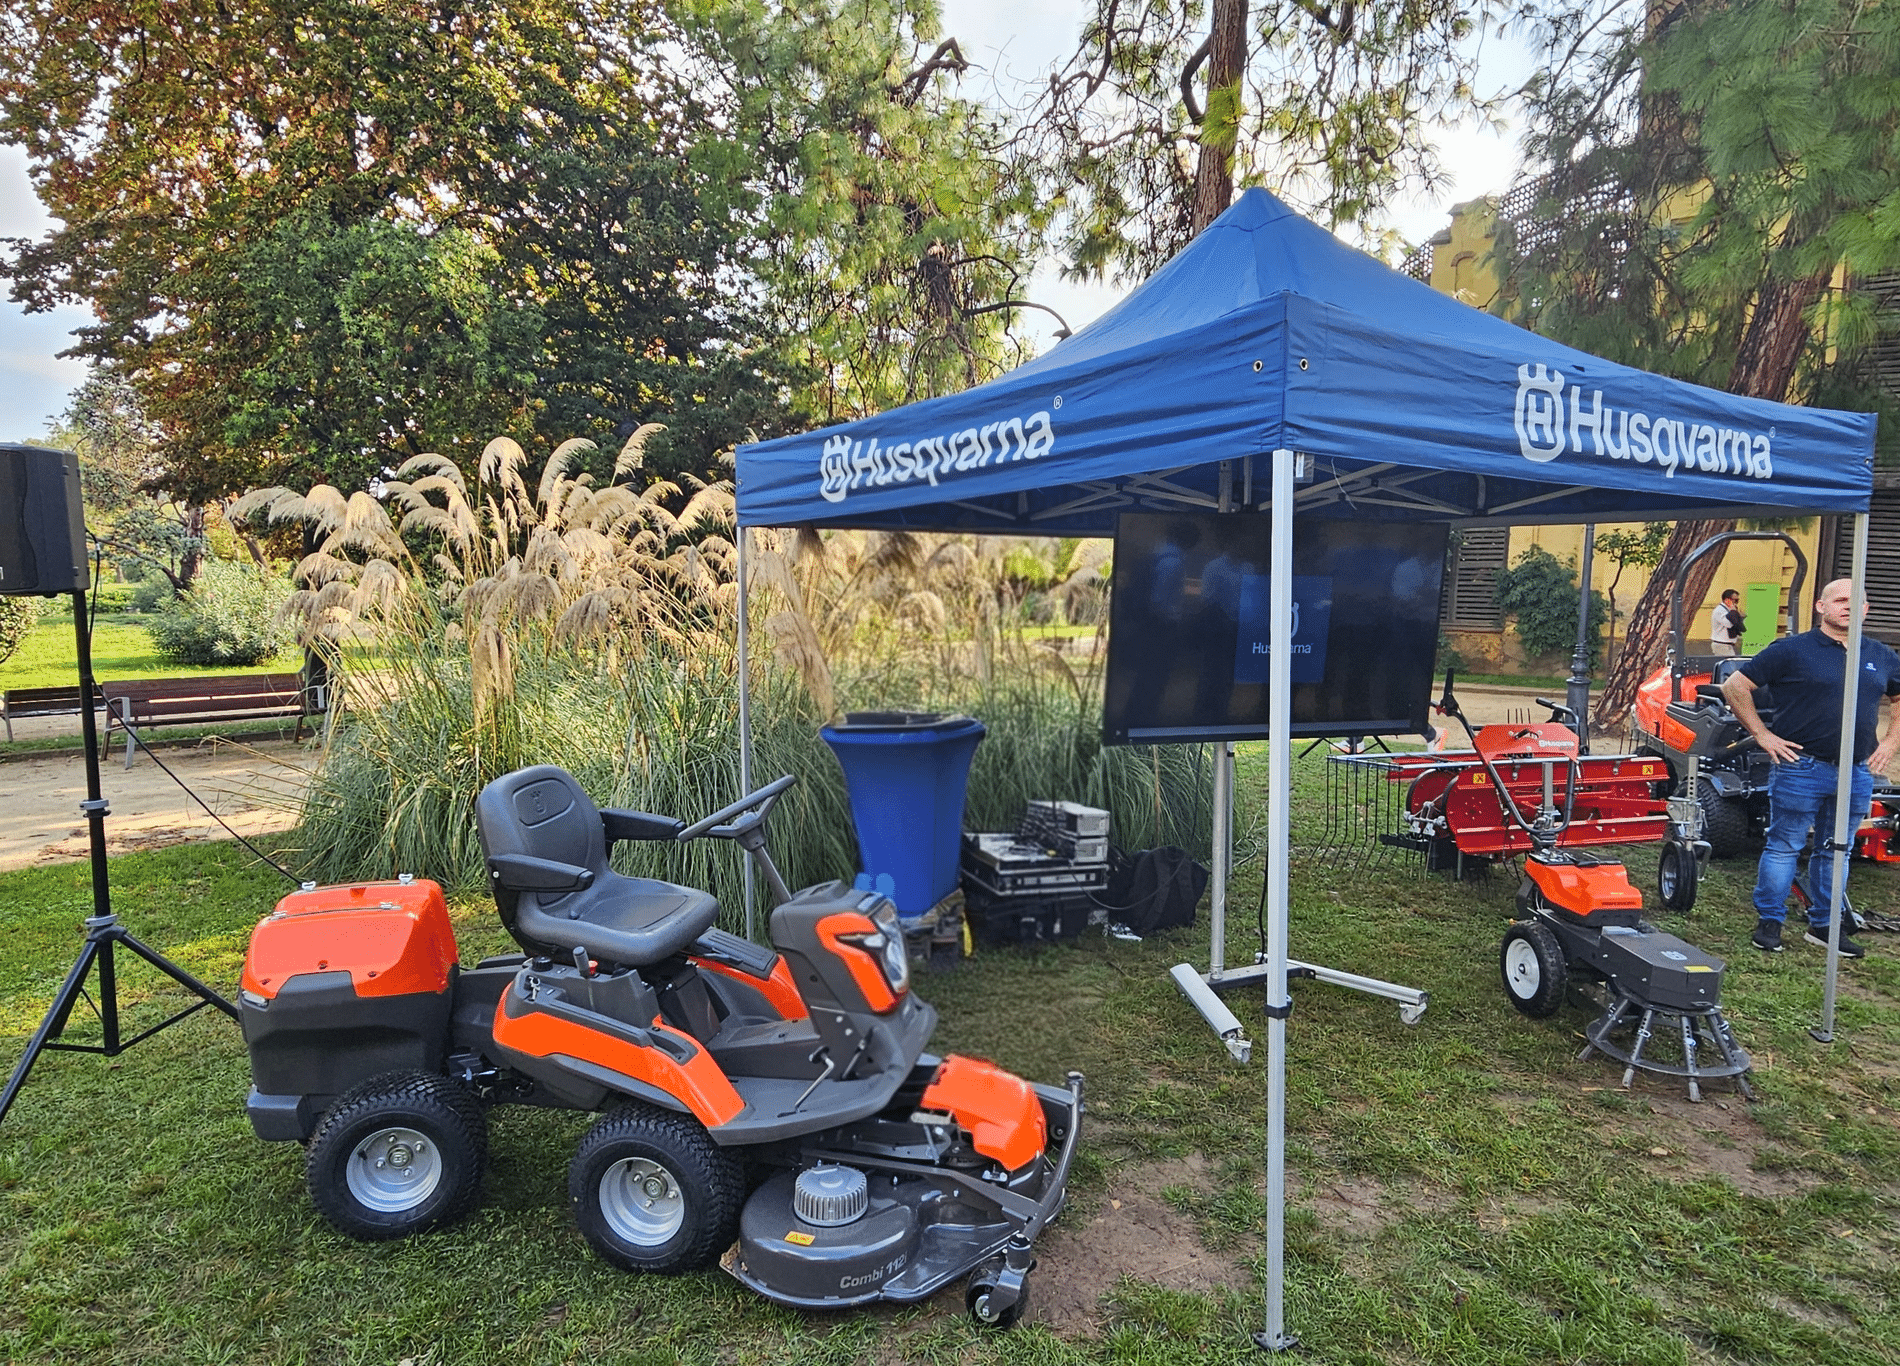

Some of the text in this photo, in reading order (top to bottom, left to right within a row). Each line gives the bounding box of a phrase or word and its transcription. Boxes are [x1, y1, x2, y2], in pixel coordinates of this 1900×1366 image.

[851, 410, 1055, 488] Husqvarna
[1569, 385, 1773, 479] Husqvarna
[1252, 642, 1312, 654] Husrna
[840, 1266, 884, 1289] Combi
